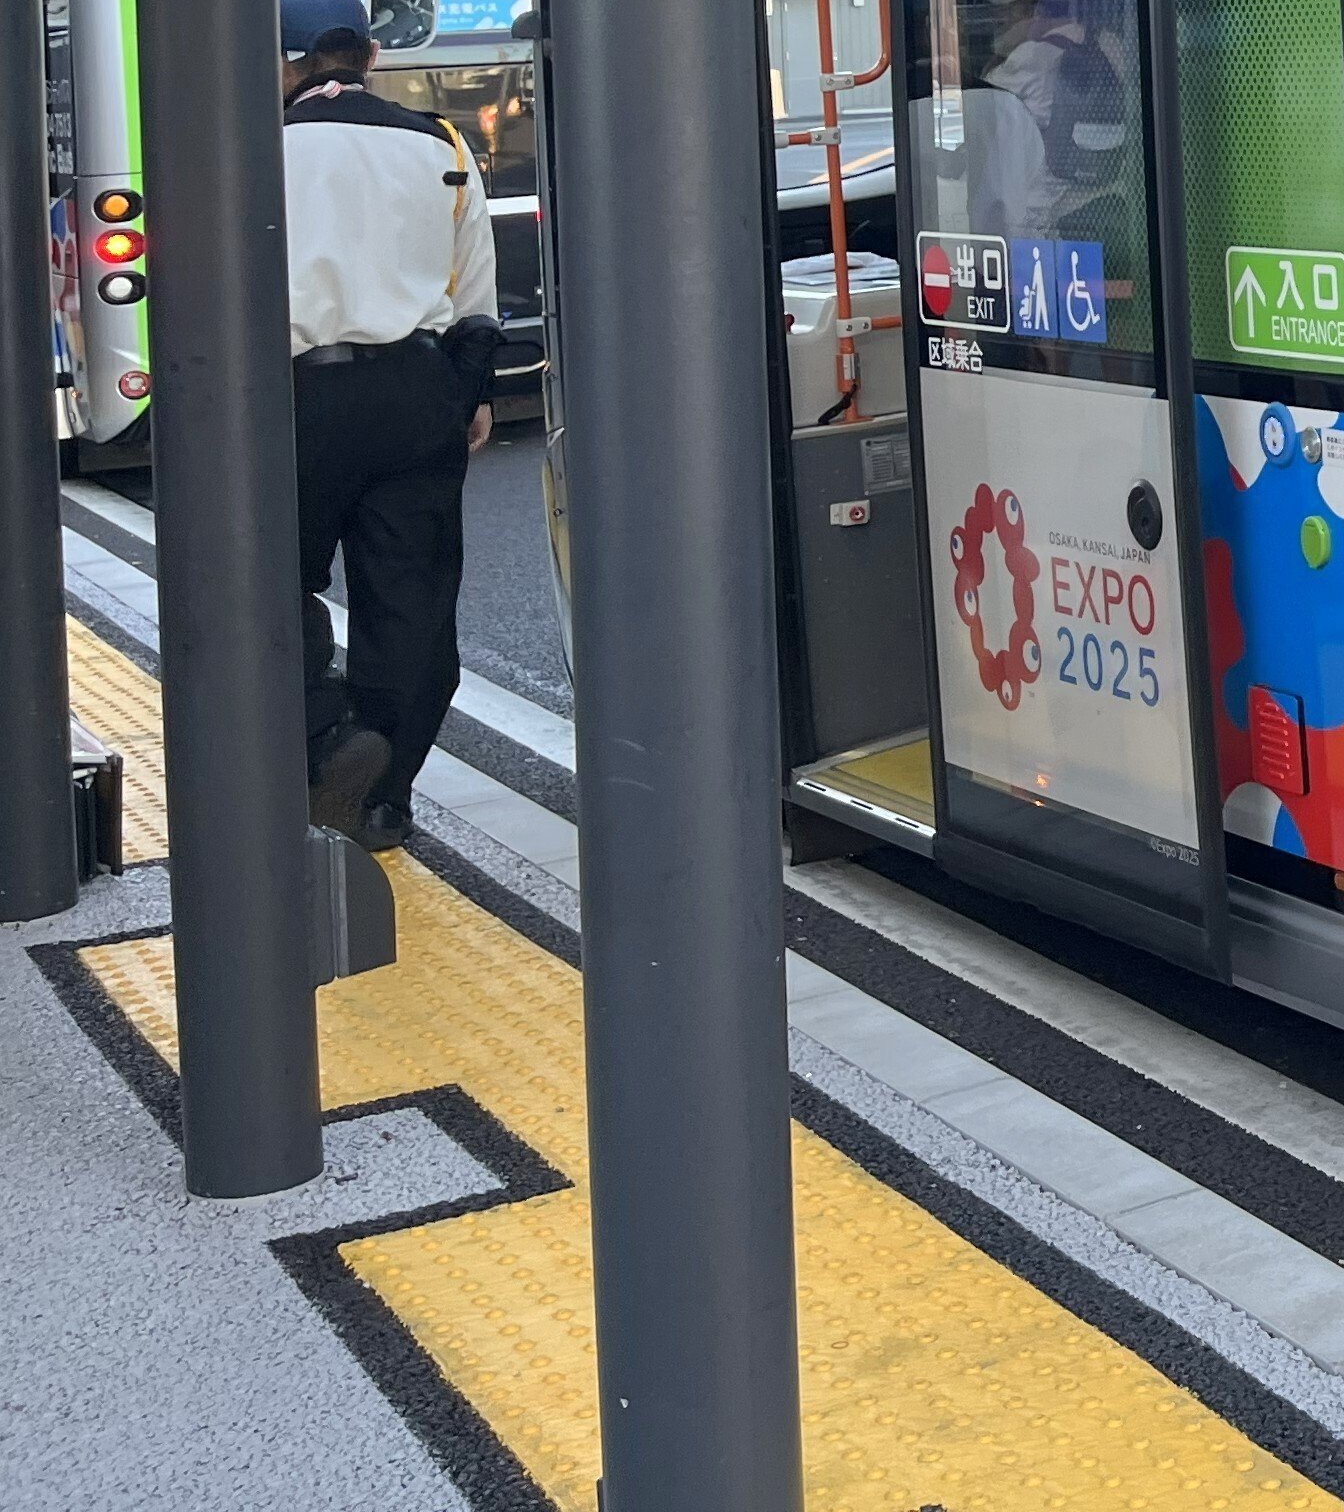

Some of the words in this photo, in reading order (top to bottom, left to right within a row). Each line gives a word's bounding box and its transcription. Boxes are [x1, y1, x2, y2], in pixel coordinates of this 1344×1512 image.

[956, 243, 1003, 290] 出口
[1276, 260, 1339, 311] 入口
[966, 295, 995, 320] EXIT
[928, 337, 984, 373] 区域乗合
[1048, 531, 1081, 550] OSAKA,
[1082, 539, 1119, 561] KANSAI,
[1120, 546, 1151, 566] JAPAN
[1050, 556, 1156, 636] EXPO
[1056, 625, 1160, 707] 2025
